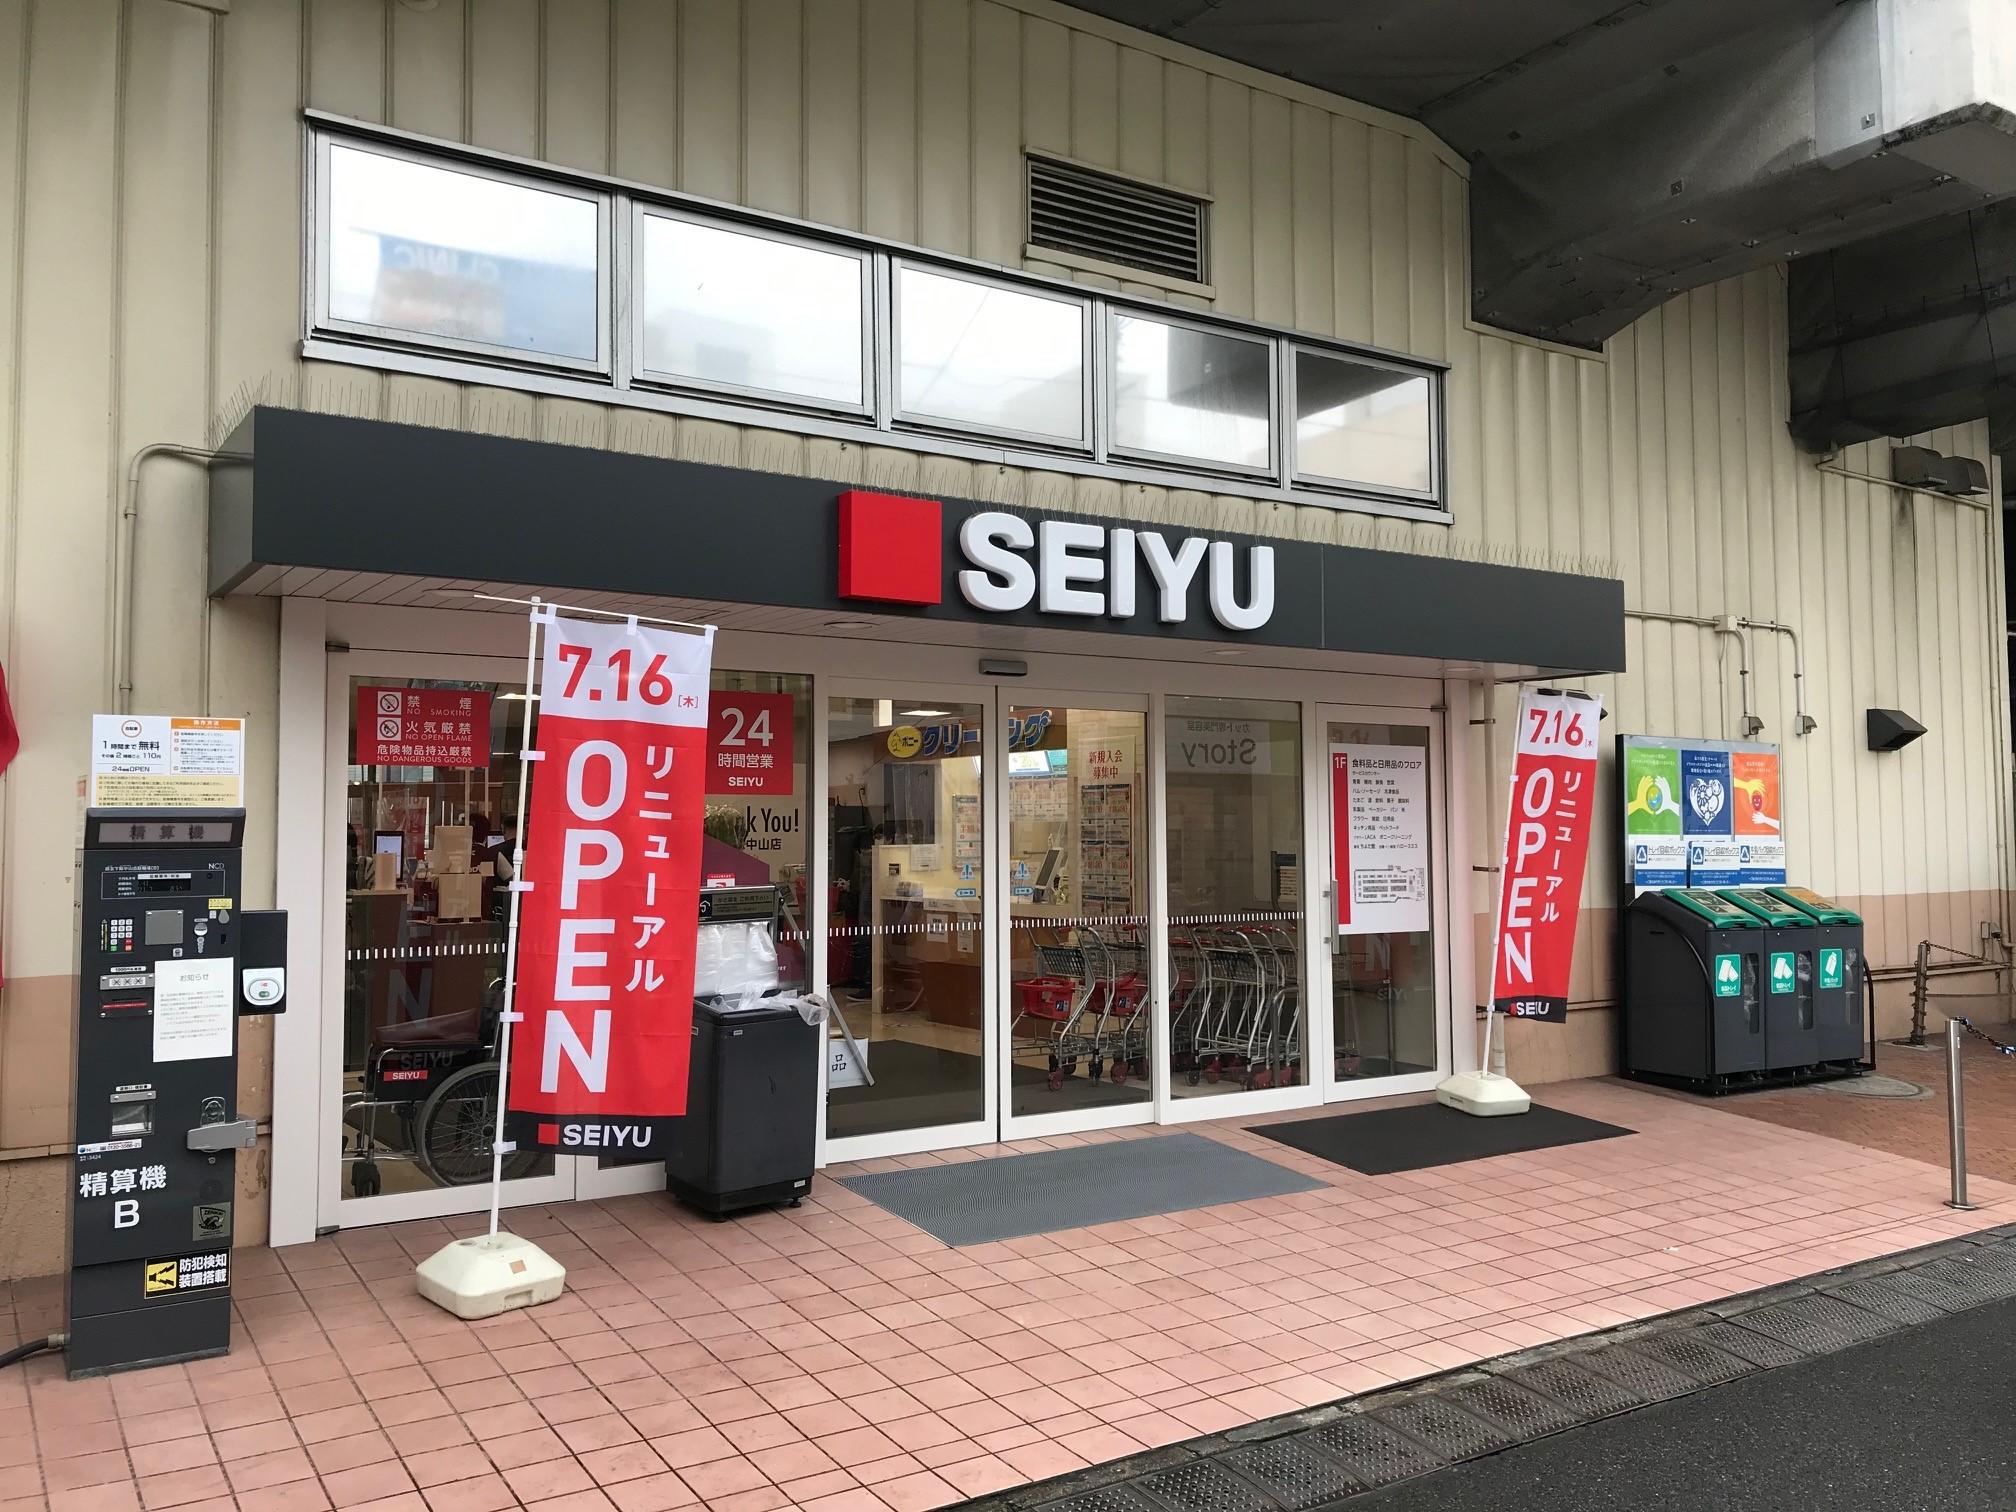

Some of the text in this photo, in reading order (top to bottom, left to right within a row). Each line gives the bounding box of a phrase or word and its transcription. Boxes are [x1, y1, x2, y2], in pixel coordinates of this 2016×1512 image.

[957, 511, 1275, 631] SEIYU
[558, 643, 673, 706] 7.16
[407, 707, 472, 717] NO SMOKING
[405, 720, 472, 735] 火気厳禁
[719, 707, 774, 747] 24
[1529, 708, 1584, 747] 7.16
[138, 741, 160, 750] 無料
[447, 734, 472, 742] FLAME
[377, 744, 472, 757] 危険物品持込厳禁
[1088, 749, 1123, 764] 新規入会
[392, 755, 442, 763] DANGEROUS
[444, 756, 472, 764] GOODS
[718, 752, 774, 769] 時間営業
[1334, 756, 1347, 769] 1F
[1352, 758, 1422, 769] 食料品と日用品のフロア
[728, 776, 764, 787] SEIYU
[1092, 766, 1119, 780] 募集中
[760, 807, 799, 833] You!
[129, 824, 204, 841] 精算機
[1540, 770, 1582, 923] リニューアル
[208, 862, 225, 870] NCD
[624, 745, 674, 993] リニューアル
[1504, 767, 1555, 985] OPEN
[539, 740, 628, 1094] OPEN
[179, 973, 209, 982] お知らせ
[392, 1070, 420, 1080] SEIYU
[562, 1123, 653, 1148] SEIYU
[79, 1164, 167, 1198] 精算機
[113, 1199, 141, 1229] B
[179, 1252, 228, 1273] 防犯検知
[179, 1268, 227, 1289] 装置搭載
